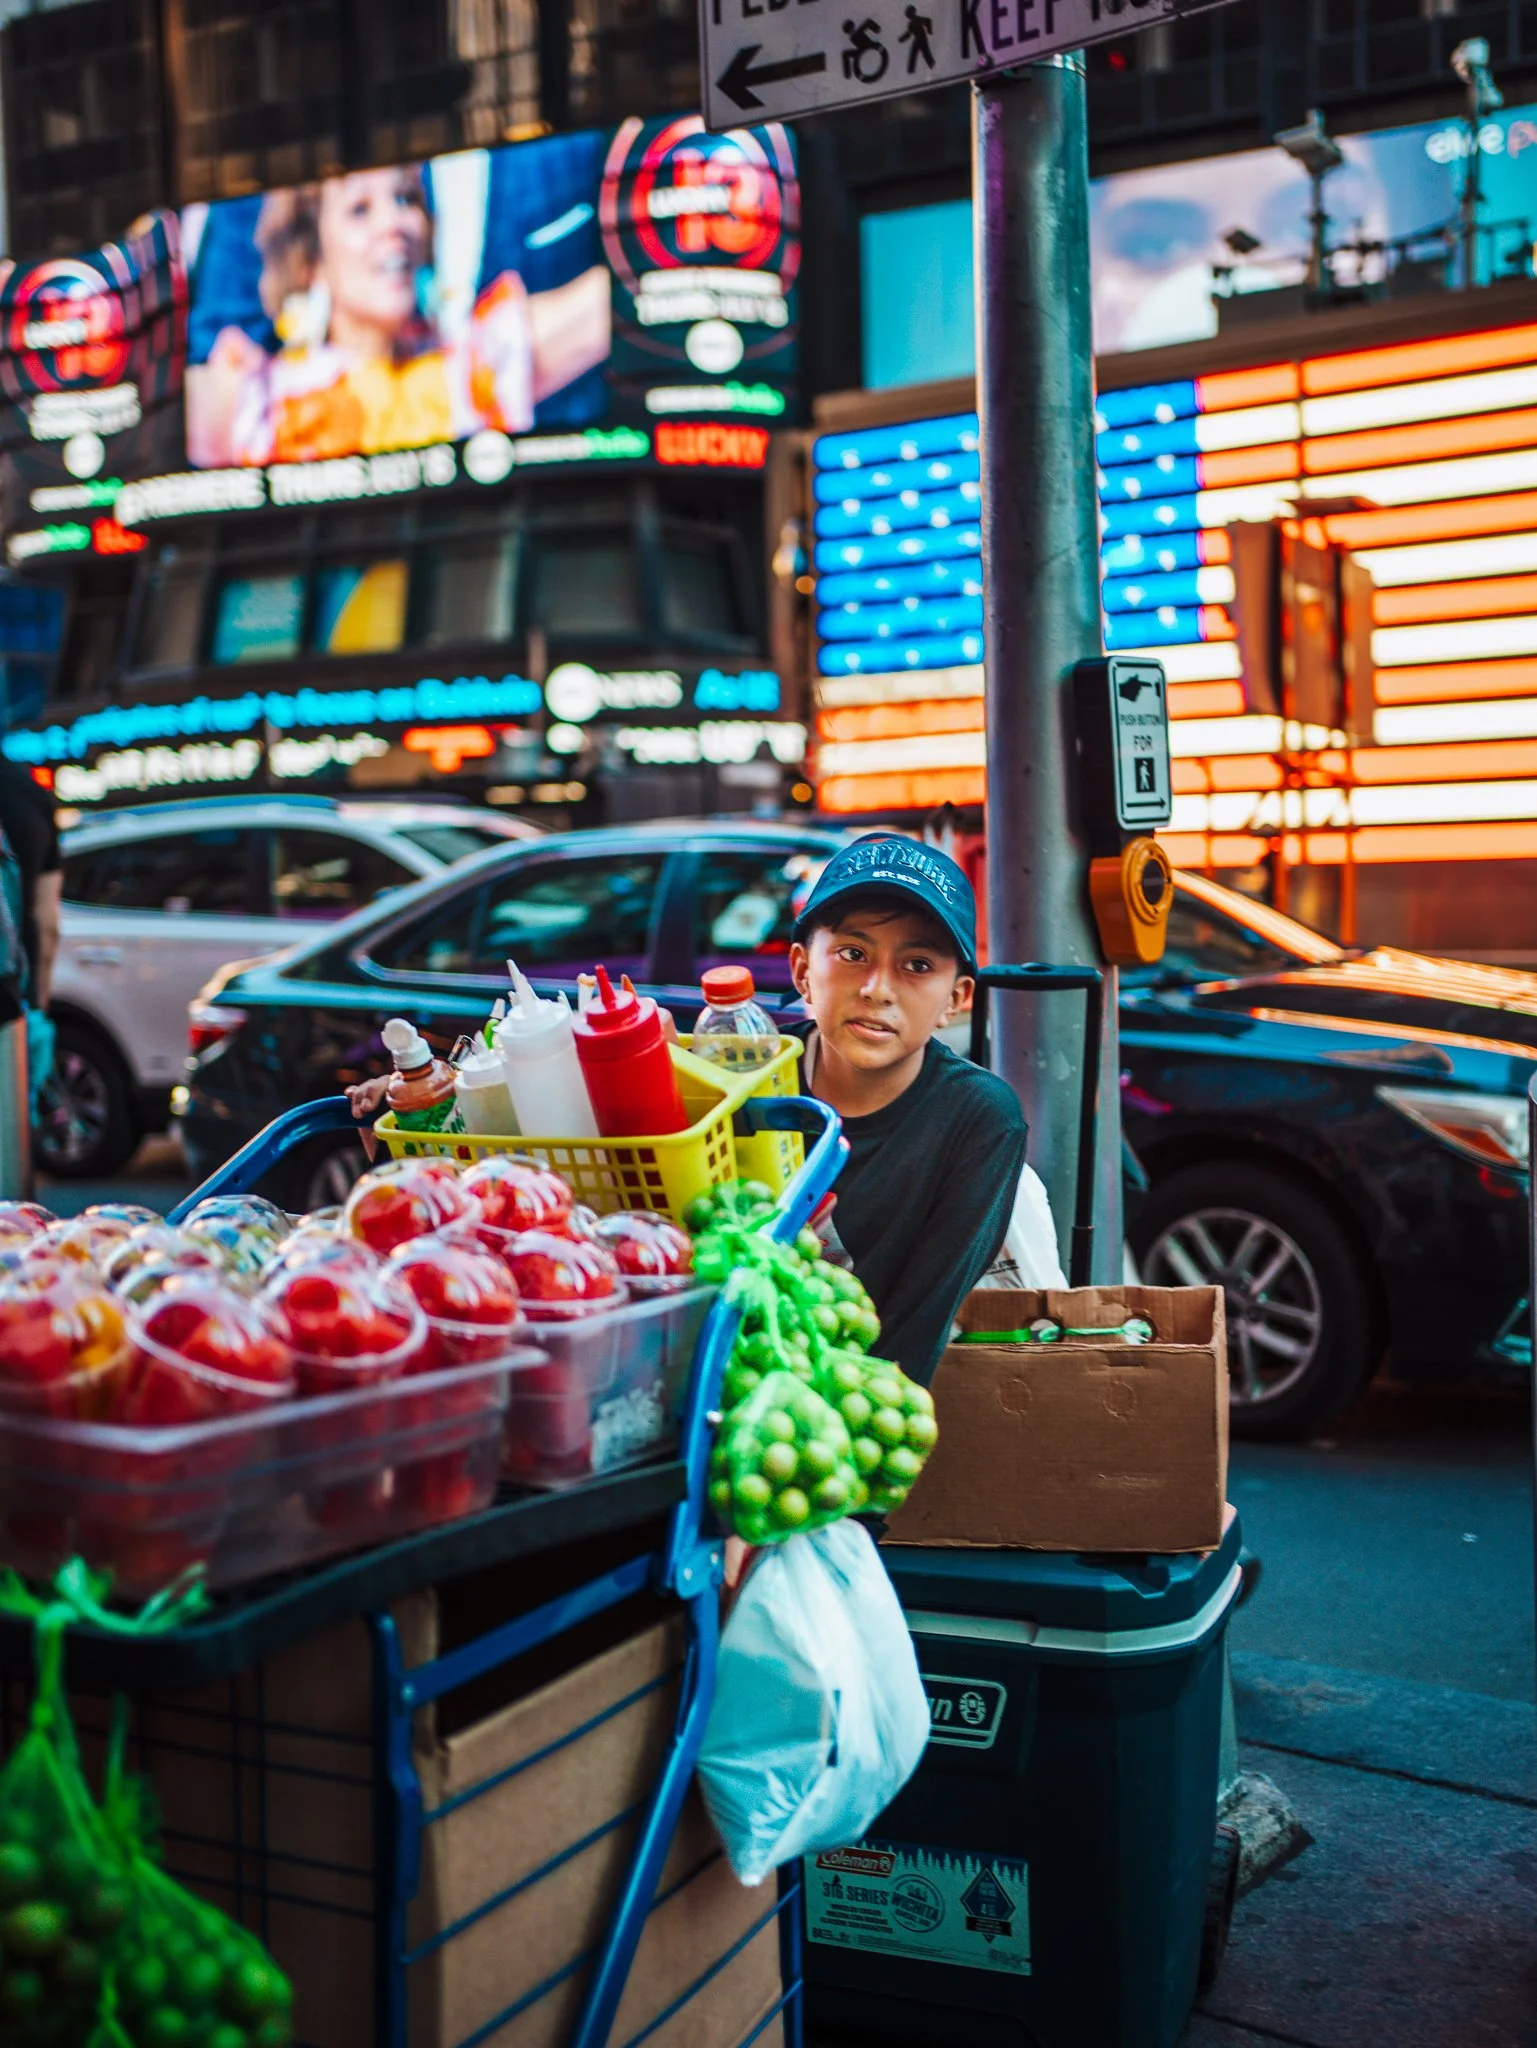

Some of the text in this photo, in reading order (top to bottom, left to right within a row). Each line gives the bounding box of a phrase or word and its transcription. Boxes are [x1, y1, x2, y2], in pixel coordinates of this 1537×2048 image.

[1119, 714, 1136, 726] PUSH
[1133, 734, 1153, 752] FOR
[822, 1850, 878, 1870] Coleman
[846, 1886, 889, 1906] SERIES
